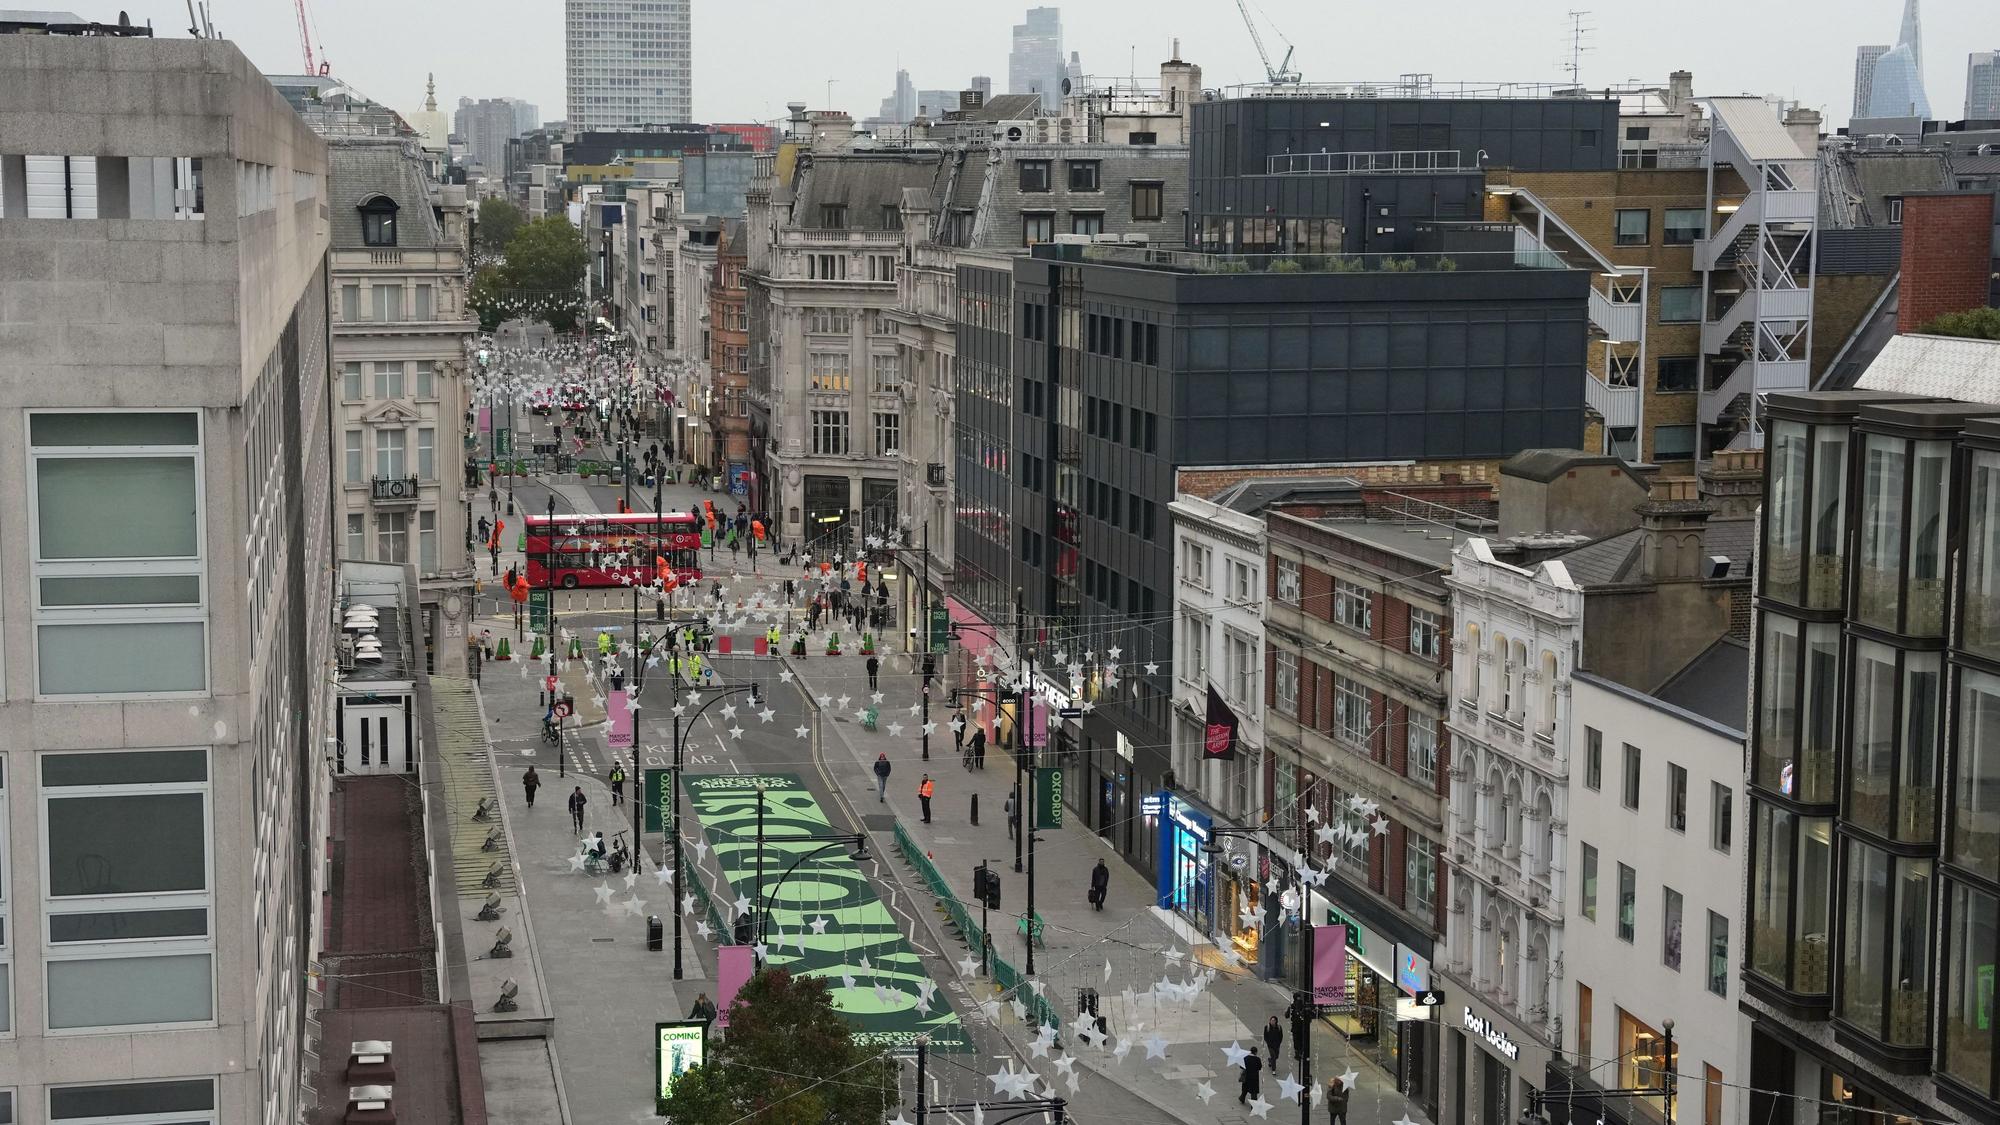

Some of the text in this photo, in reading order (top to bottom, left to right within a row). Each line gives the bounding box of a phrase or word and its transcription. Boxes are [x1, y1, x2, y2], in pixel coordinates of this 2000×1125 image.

[645, 755, 718, 766] CLAR
[660, 773, 671, 819] OXFORD
[1052, 771, 1062, 817] OXFORD
[663, 1032, 701, 1041] COMING
[1464, 1006, 1517, 1060] Foot Locker
